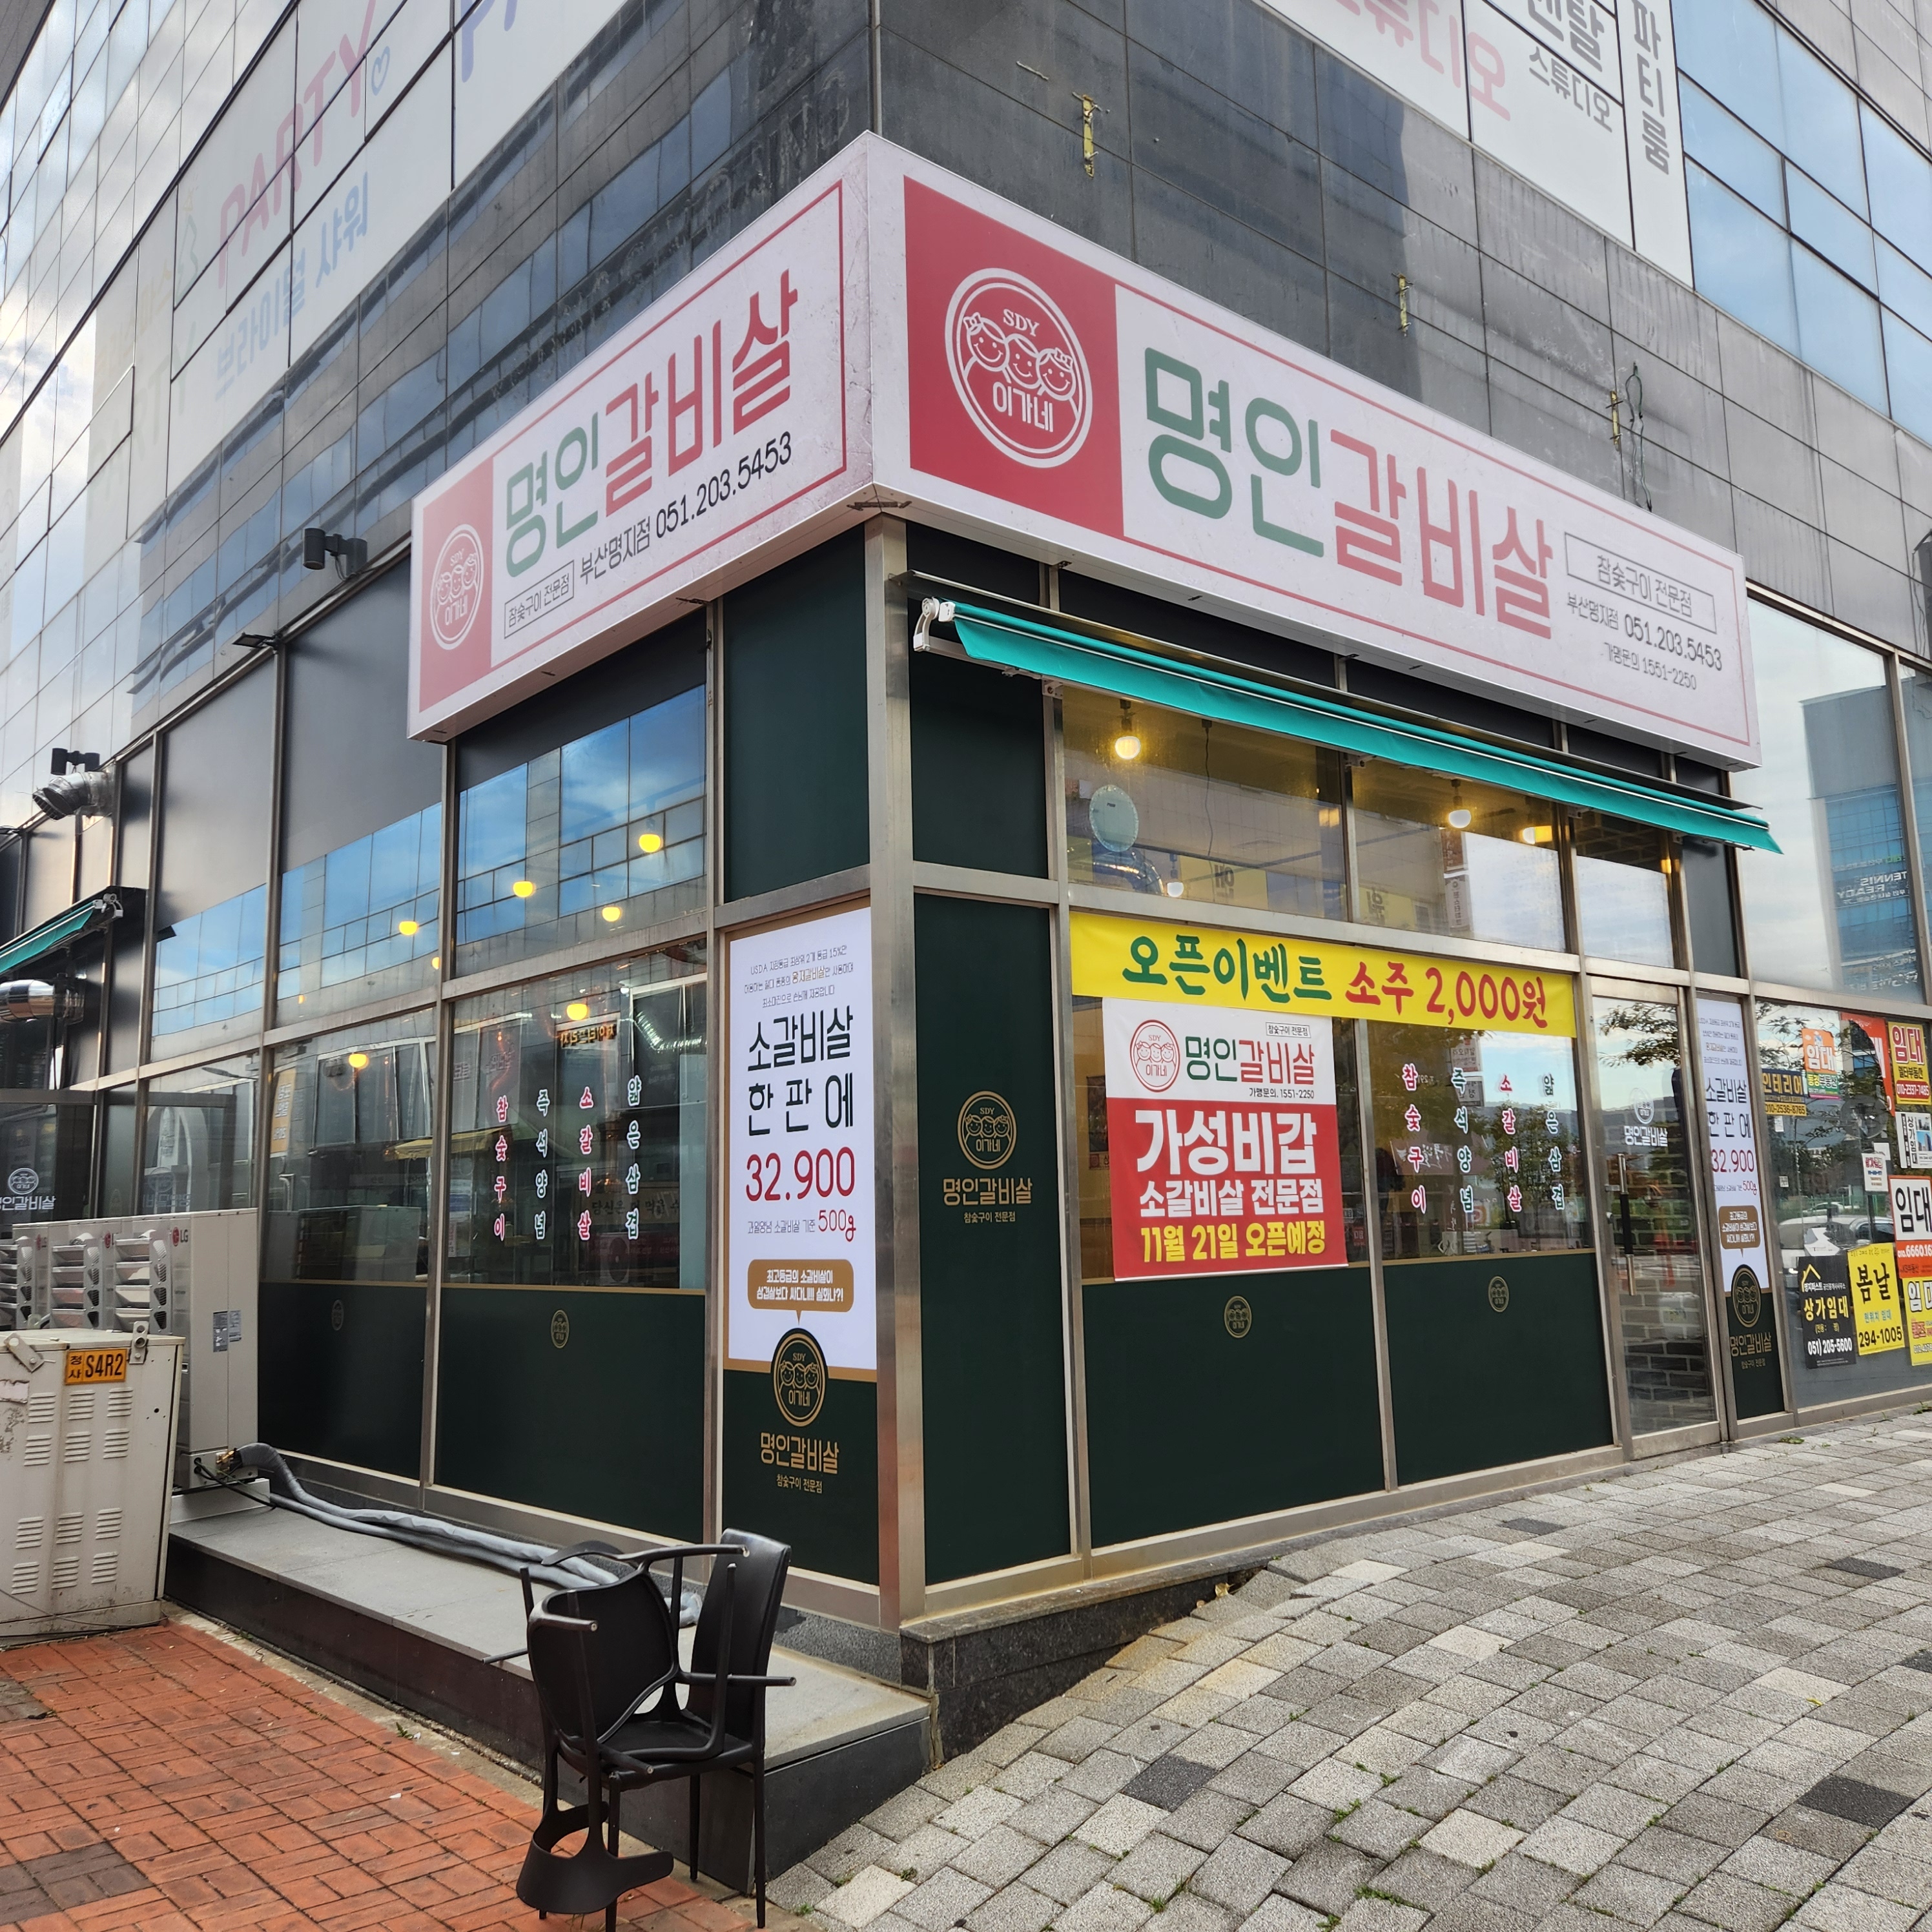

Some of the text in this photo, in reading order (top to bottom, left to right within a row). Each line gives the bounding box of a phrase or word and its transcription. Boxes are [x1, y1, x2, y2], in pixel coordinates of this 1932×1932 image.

[1330, 0, 1511, 121] 튜디오
[1528, 46, 1614, 134] 스튜디오
[1632, 0, 1670, 176] 파티룸
[215, 171, 368, 402] 브라이덜 샤워
[1003, 309, 1040, 337] SDY
[506, 268, 798, 579] 명인갈비살
[992, 380, 1054, 433] 이가네
[580, 431, 793, 585] 부산명지점 051.203.5453
[1145, 347, 1553, 639] 명인갈비살
[508, 573, 570, 628] 참숯구이 전문점
[1597, 555, 1692, 618] 참숯구이 전문점
[445, 595, 468, 626] 이가네
[1567, 592, 1723, 671] 부산명지점 051.203.5453
[1605, 642, 1697, 690] 가맹문의 1551-2250
[750, 963, 768, 975] USDA
[1122, 934, 1548, 1029] 오픈이벤트 소주 2,000원
[748, 1005, 854, 1071] 소갈비살
[1268, 1024, 1309, 1037] 참숯구이 전문점
[1892, 1025, 1925, 1065] 임대
[1146, 1064, 1167, 1077] 이가네
[1185, 1035, 1315, 1086] 명인갈비살
[1807, 1045, 1836, 1071] 임대
[1280, 1089, 1315, 1099] 1551-2250
[1705, 1077, 1747, 1105] 소갈비살
[1762, 1073, 1804, 1094] 인테리어
[976, 1139, 1000, 1152] 이가네
[1135, 1109, 1317, 1176] 가성비갑
[1402, 1063, 1426, 1214] 참숯구이
[1451, 1067, 1474, 1214] 즉석양념
[1499, 1074, 1521, 1212] 소갈비살
[1624, 1125, 1668, 1147] 명인갈비살
[494, 1094, 508, 1241] 참숯구이
[535, 1089, 550, 1240] 즉석양념
[578, 1086, 593, 1240] 소갈비살
[746, 1147, 856, 1202] 32.900
[1711, 1149, 1755, 1173] 32.900
[0, 1196, 57, 1211] 인갈비살
[943, 1178, 1033, 1206] 명인갈비살
[1140, 1178, 1324, 1218] 소갈비살 전문점
[1743, 1180, 1758, 1195] 500g
[774, 1220, 800, 1233] 소갈비살
[802, 1219, 816, 1233] 기준
[818, 1209, 856, 1242] 500g
[964, 1211, 1016, 1224] 참숯구이 전문점
[1895, 1186, 1932, 1233] 임대
[180, 1229, 189, 1243] LG
[1141, 1220, 1326, 1263] 11월 21일 오픈예정
[766, 1269, 833, 1284] 최고등급의 소갈비살이
[1804, 1295, 1849, 1321] 상가임대
[792, 1353, 806, 1361] SDY
[1730, 1331, 1772, 1357] 명인갈비살
[1822, 1337, 1853, 1355] 205-5600
[1858, 1326, 1902, 1348] 294-1005
[85, 1353, 123, 1377] S4R2
[788, 1390, 810, 1407] 이가네
[760, 1432, 839, 1474] 명인갈비살
[776, 1474, 823, 1494] 참숯구이 전문점
